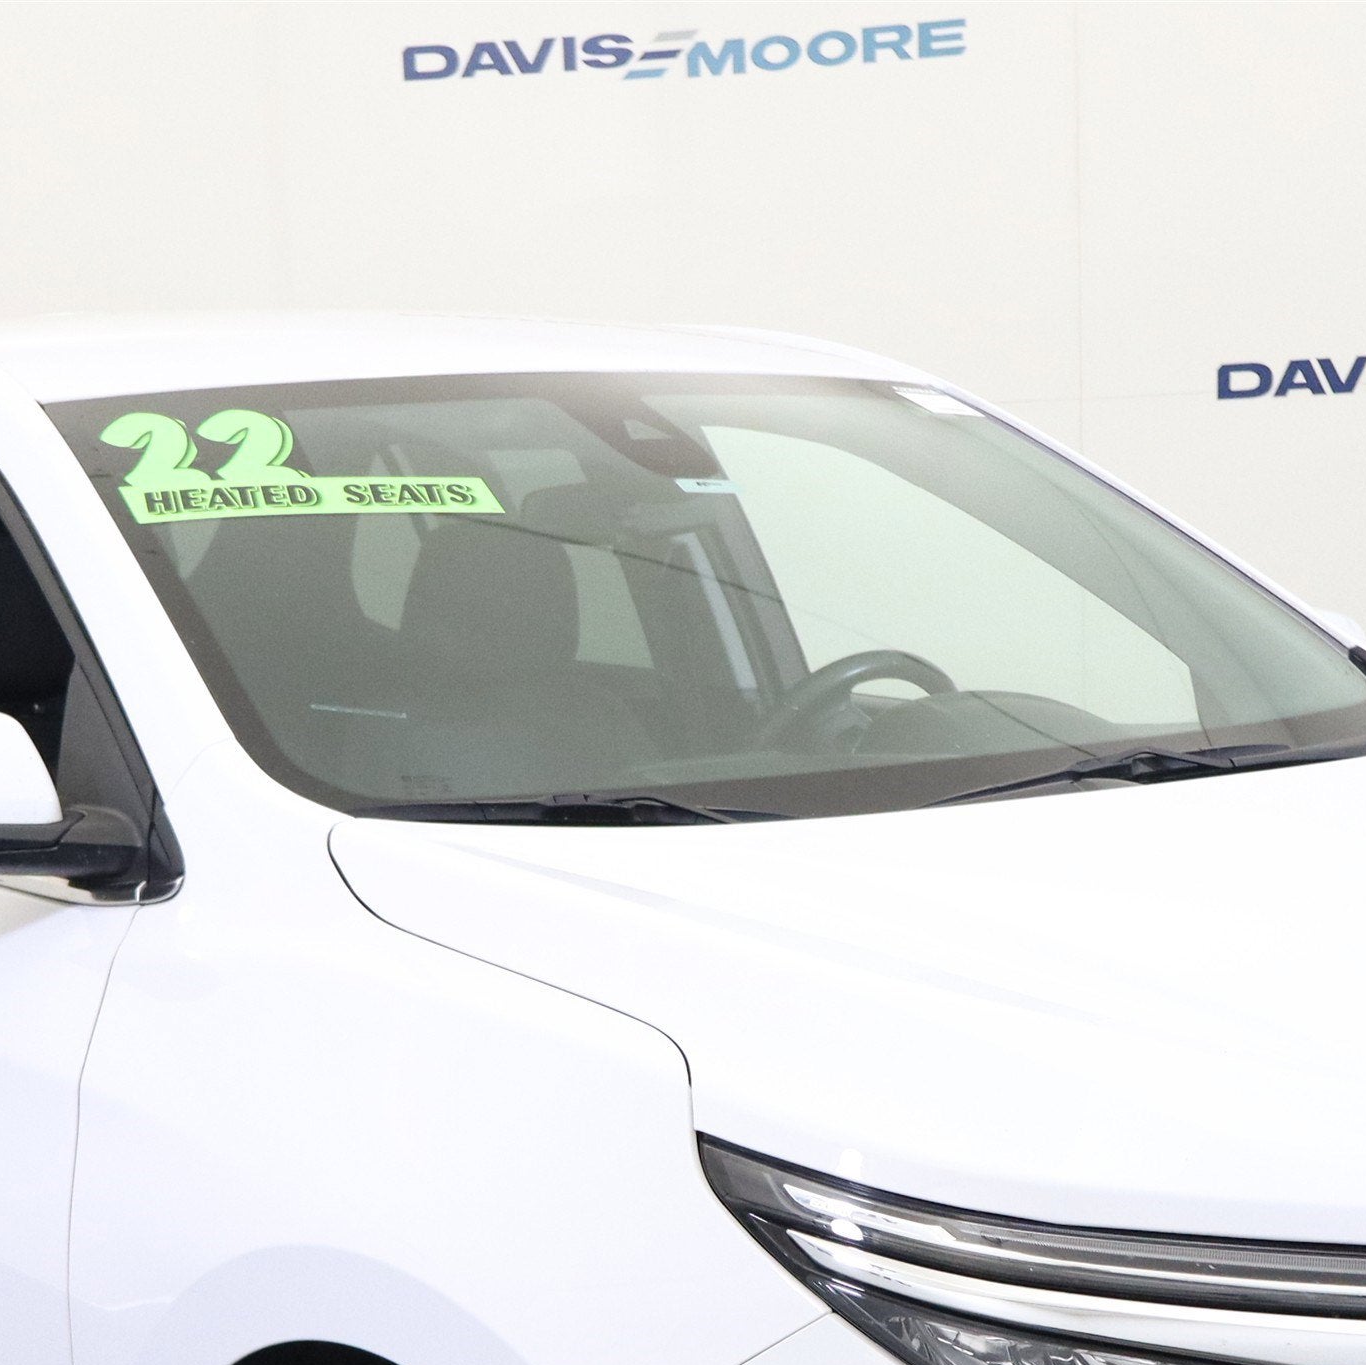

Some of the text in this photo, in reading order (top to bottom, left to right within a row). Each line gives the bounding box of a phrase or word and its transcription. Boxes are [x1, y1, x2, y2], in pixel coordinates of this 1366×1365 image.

[401, 18, 966, 82] DAVIS MOORE
[99, 408, 311, 485] 22
[143, 483, 477, 515] HEATED SEATS
